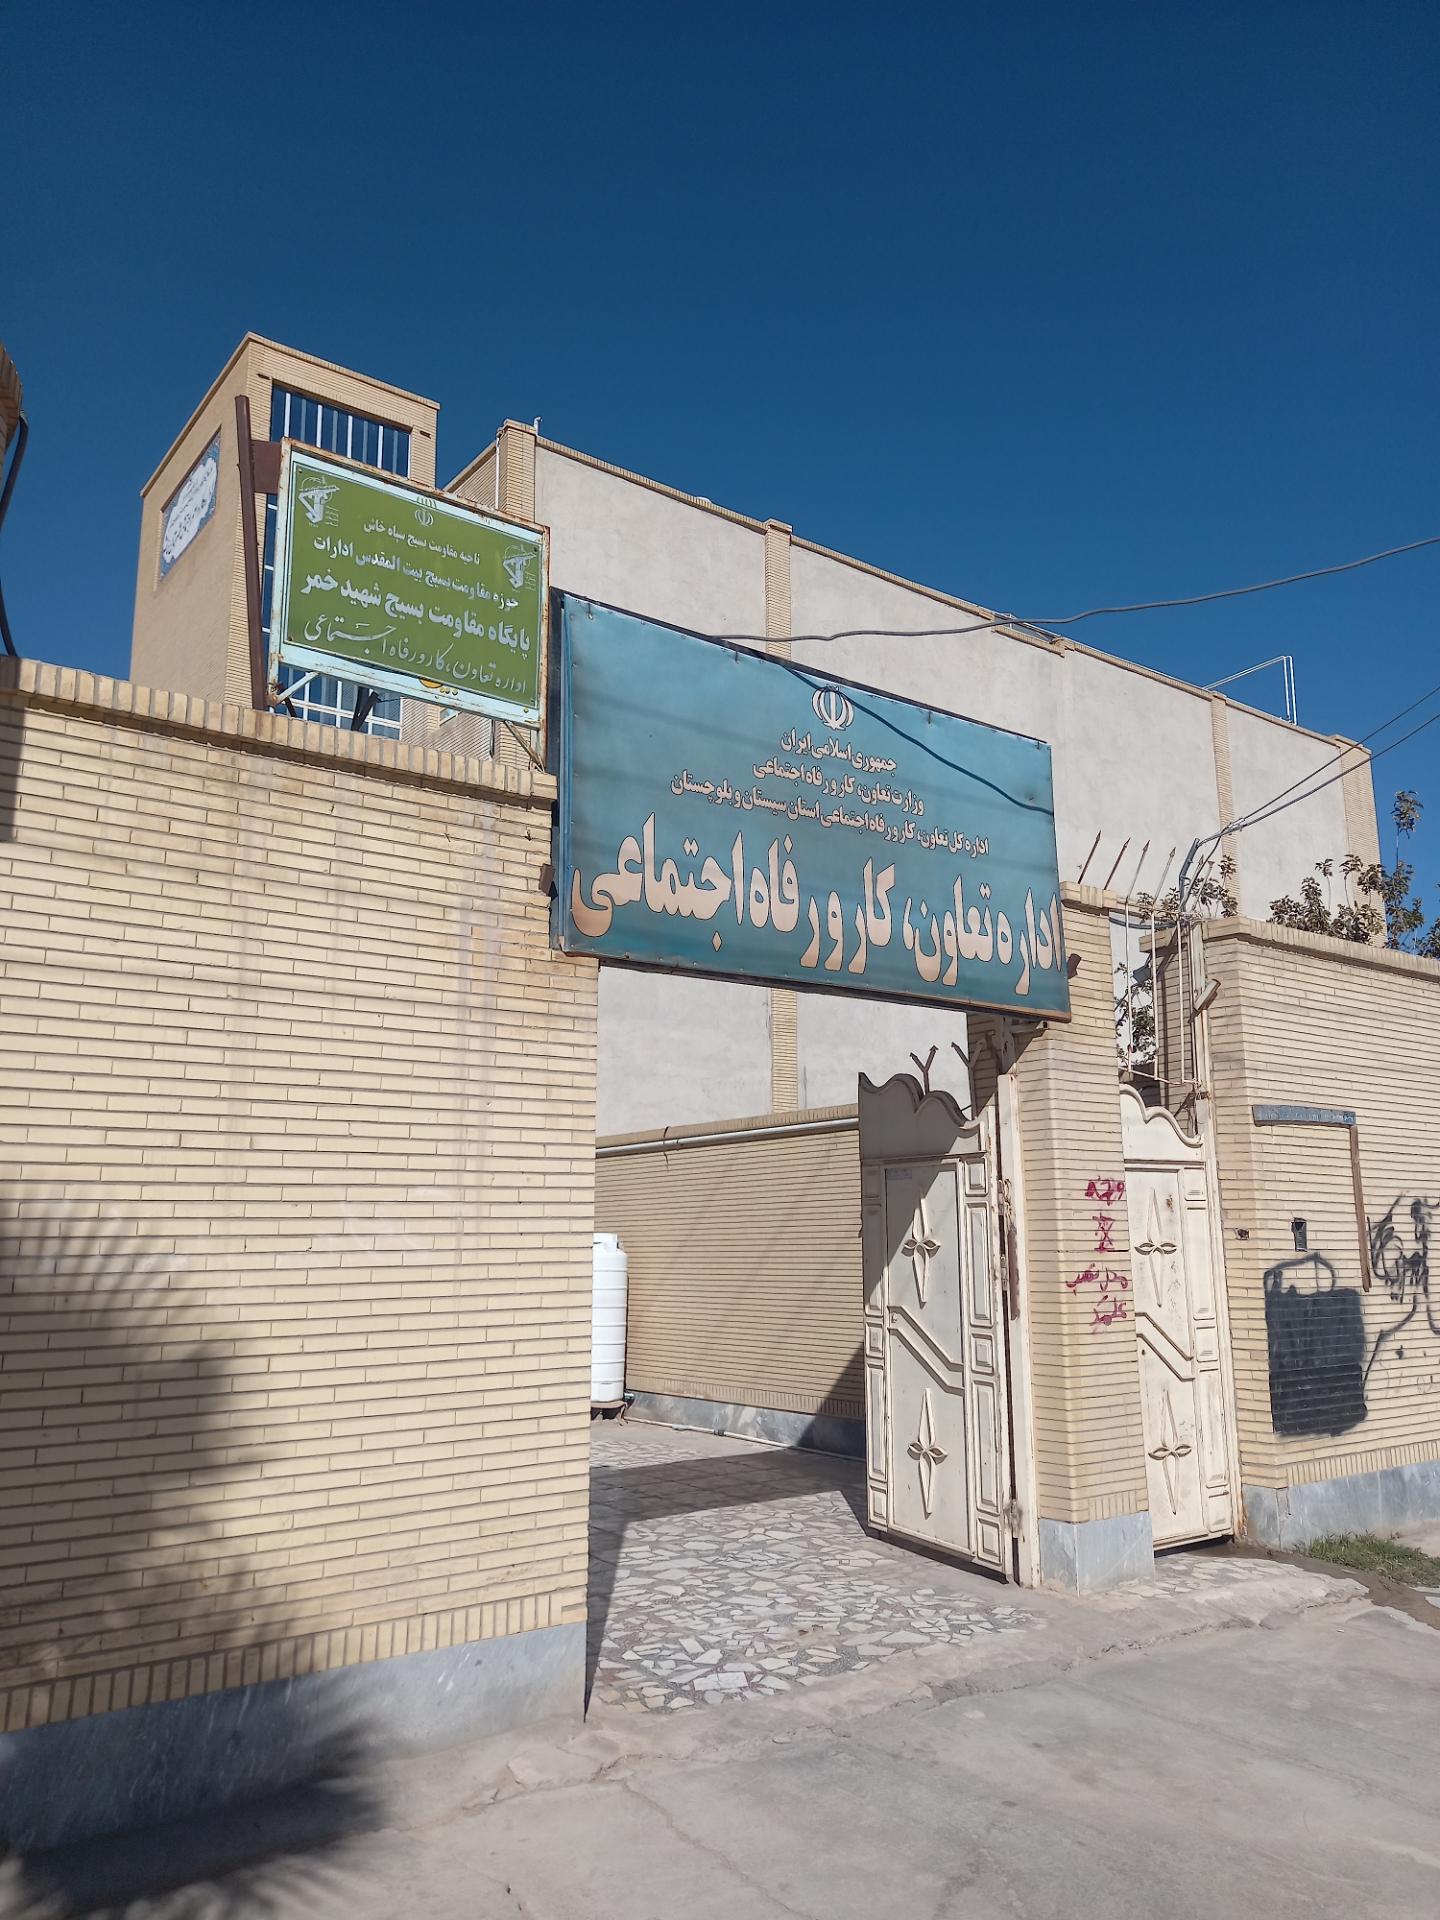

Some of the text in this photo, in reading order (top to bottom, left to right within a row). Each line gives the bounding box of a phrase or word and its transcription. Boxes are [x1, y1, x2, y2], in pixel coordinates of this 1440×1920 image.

[407, 533, 427, 548] بسیج
[428, 541, 457, 559] مقاومت
[313, 535, 519, 611] حوزه مقاومت بسیج بیت المقدس ادارات
[460, 552, 480, 566] ناحیه
[300, 568, 530, 660] پایگاه مقاومت بسیج شهید خمر
[303, 613, 397, 655] اجتماعی
[389, 637, 417, 662] رفاه
[495, 677, 526, 693] اداره
[780, 727, 897, 777] جمهوری اسلامی ایران
[752, 756, 805, 786] اجتماعی
[805, 765, 829, 795] رفاه
[670, 768, 733, 806] بلوچستان
[733, 789, 742, 809] و
[830, 778, 837, 796] و
[838, 773, 855, 798] کار
[742, 784, 787, 816] سیستان
[787, 796, 820, 821] استان
[890, 788, 925, 816] وزارت
[820, 805, 869, 835] اجتماعی
[869, 813, 892, 841] رفاه
[892, 825, 899, 843] و
[899, 819, 916, 844] کار
[948, 830, 964, 854] کل
[965, 836, 990, 859] اداره
[571, 811, 744, 952] اجتماعی
[750, 833, 820, 969] رفاه
[848, 856, 896, 974] کار
[824, 890, 844, 971] و
[997, 887, 1062, 996] اداره
